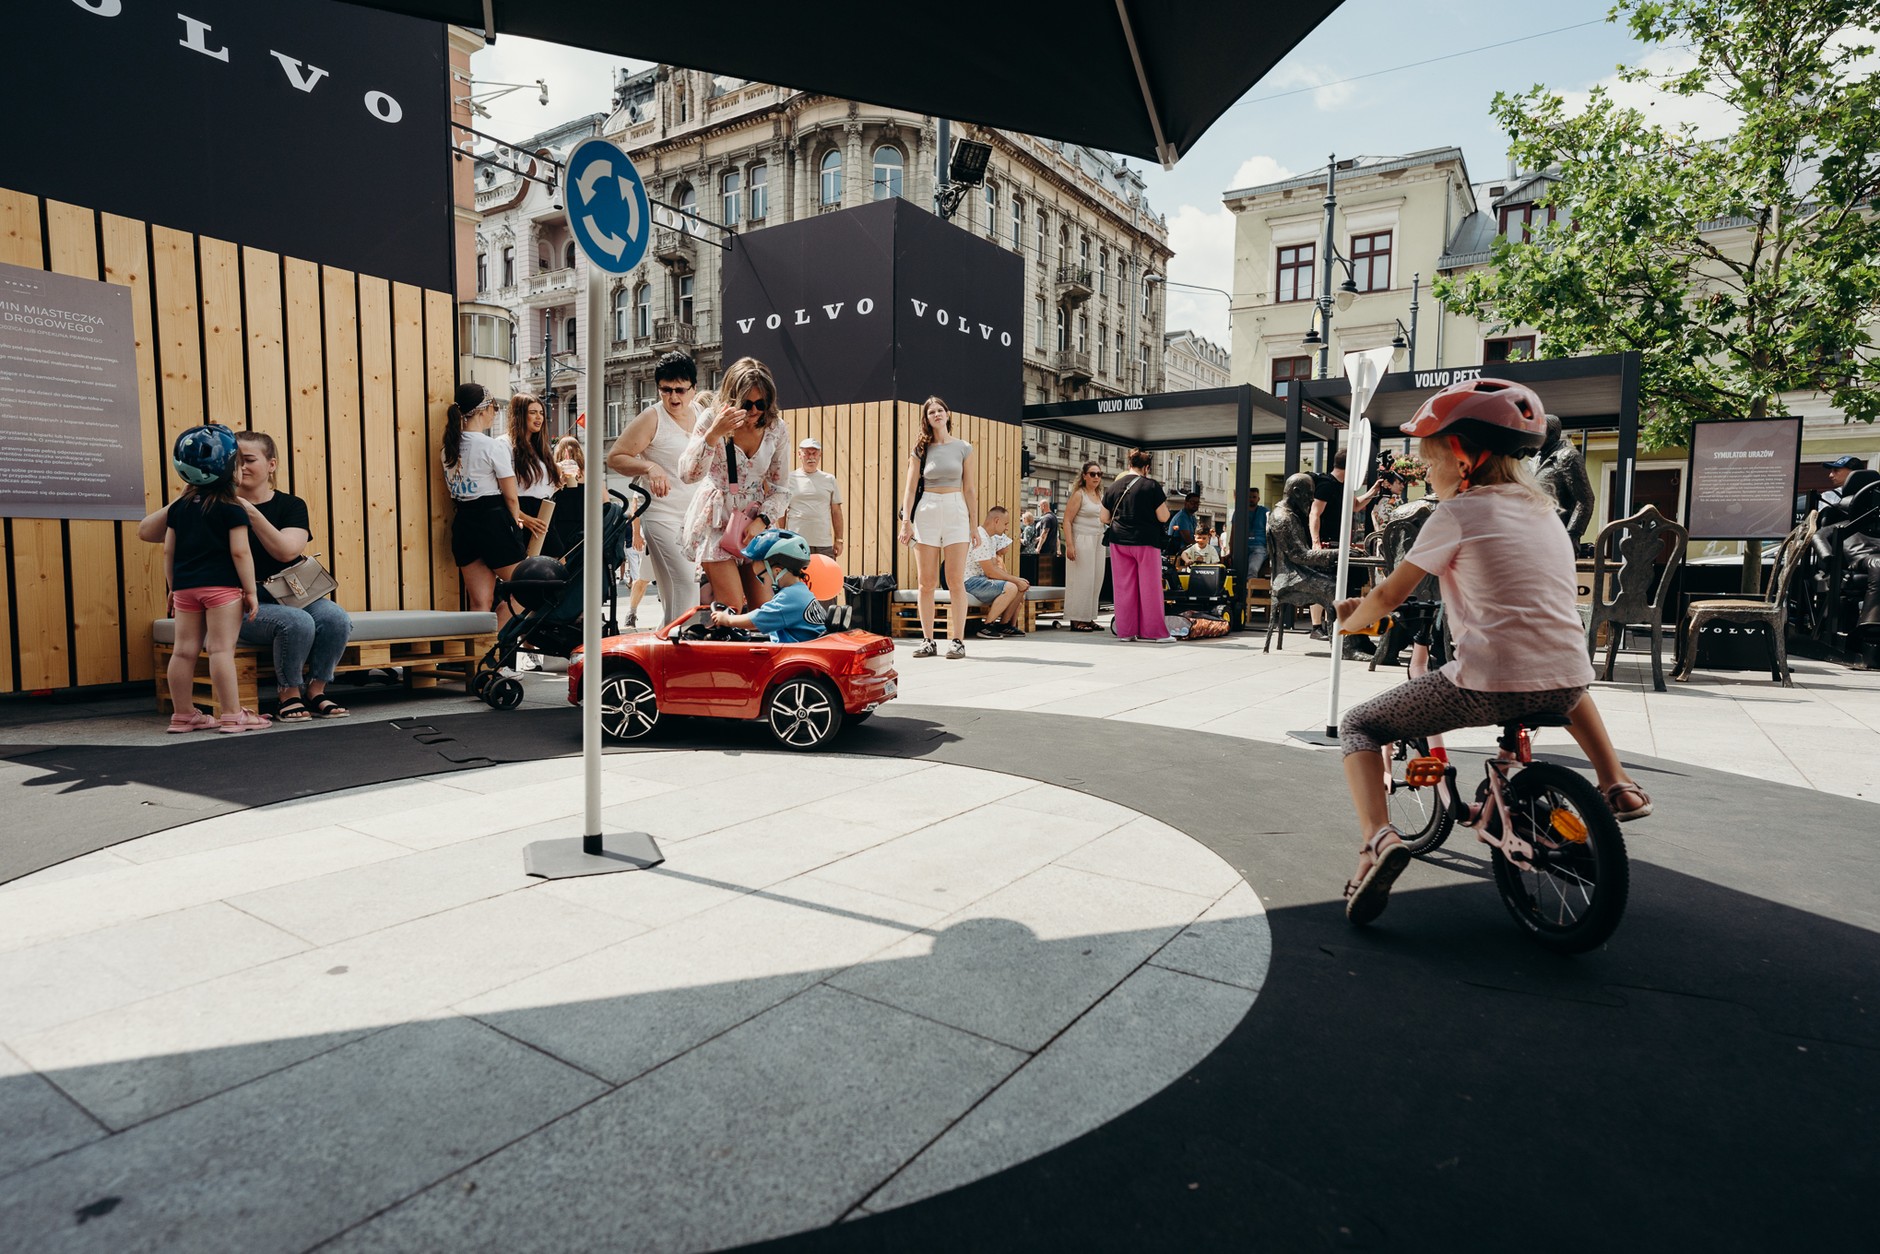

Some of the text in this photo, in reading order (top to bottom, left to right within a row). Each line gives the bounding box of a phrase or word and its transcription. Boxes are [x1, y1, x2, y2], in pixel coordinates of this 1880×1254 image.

[4, 312, 94, 334] DROGOWEGO
[24, 304, 104, 326] MIASTECZKA
[737, 297, 875, 334] VOLVO
[911, 298, 1013, 347] VOLVO
[1415, 371, 1450, 388] VOLVO
[1098, 398, 1144, 413] VOLVO KIDS
[1713, 449, 1775, 459] SYMULATOR URAZÓW
[1700, 627, 1765, 635] VOLV
